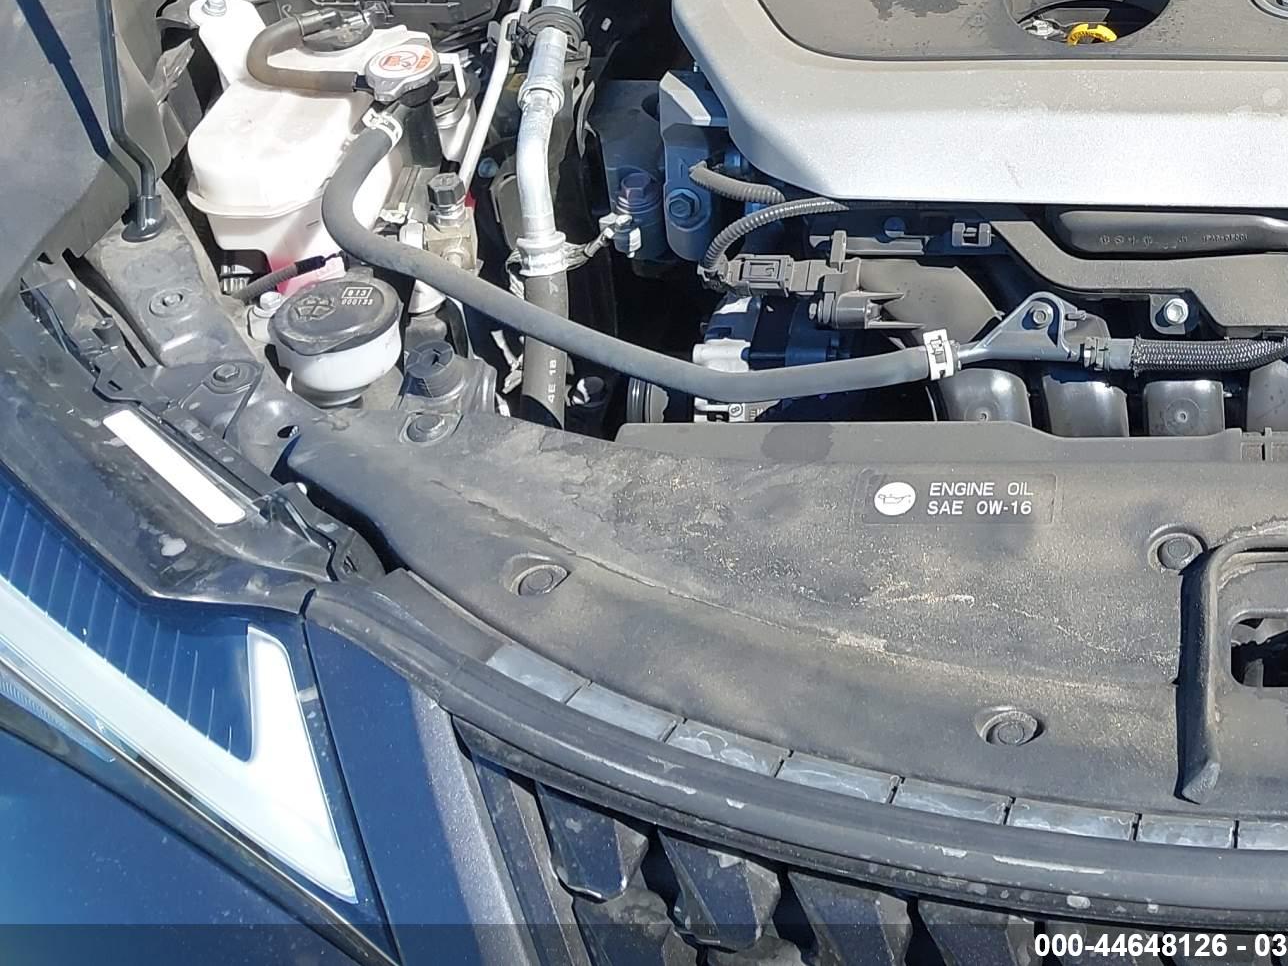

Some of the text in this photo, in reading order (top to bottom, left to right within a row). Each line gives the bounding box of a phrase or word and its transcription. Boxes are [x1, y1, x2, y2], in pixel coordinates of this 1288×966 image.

[929, 482, 1034, 497] ENGINE OIL
[927, 500, 1032, 515] SAE 0W-16
